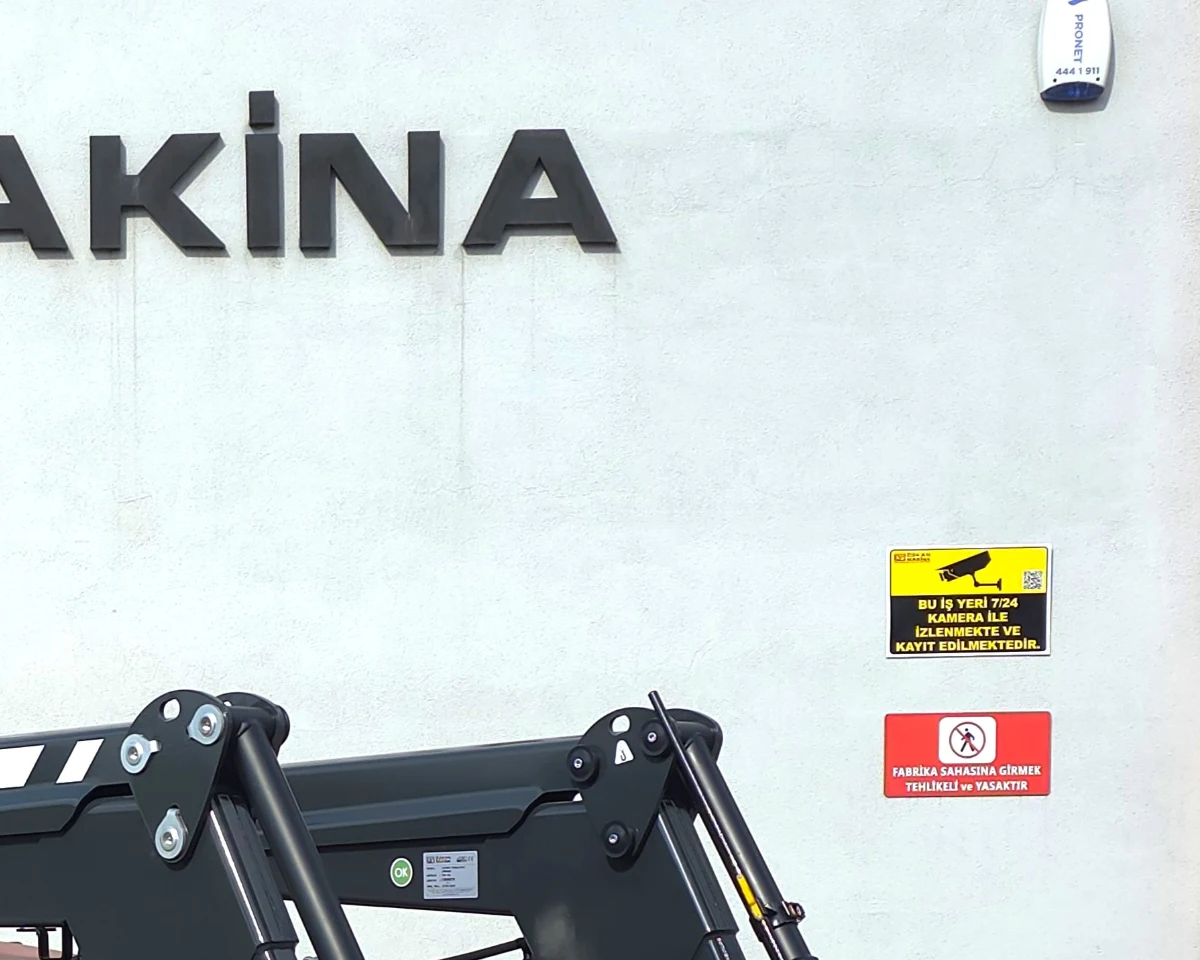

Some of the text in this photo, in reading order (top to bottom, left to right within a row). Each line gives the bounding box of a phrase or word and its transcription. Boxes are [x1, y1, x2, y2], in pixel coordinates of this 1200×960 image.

[1073, 14, 1084, 64] PRONET
[1055, 67, 1076, 76] 444
[1085, 66, 1100, 75] 911
[918, 596, 1019, 612] BU İŞ YERİ 7/24
[927, 610, 1009, 624] KAMERA İLE
[915, 625, 1021, 638] İZLENMEKTE VE
[895, 637, 1041, 652] KAYIT EDİLMEKTEDİR.
[892, 763, 1042, 777] FABRİKA SAHASINA GİRMEK
[905, 779, 1029, 792] TEHLİKELİ ve YASAKTIR
[394, 867, 409, 878] OK
